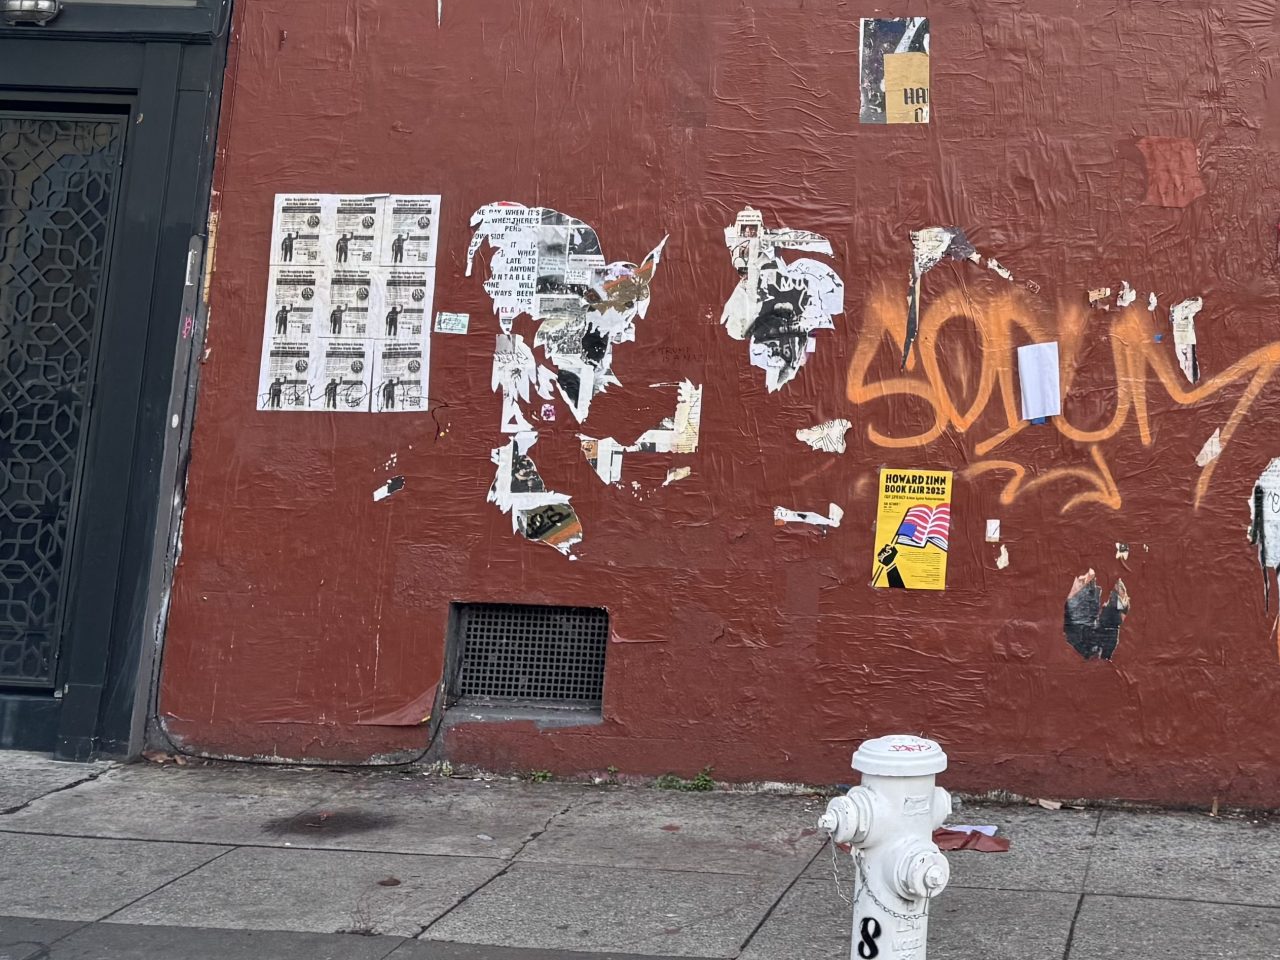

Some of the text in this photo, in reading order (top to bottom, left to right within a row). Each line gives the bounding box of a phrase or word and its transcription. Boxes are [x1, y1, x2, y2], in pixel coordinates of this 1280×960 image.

[885, 474, 947, 486] HOWARD ZINN
[884, 484, 946, 495] BOOK FAIR 2025
[857, 917, 882, 960] 8
